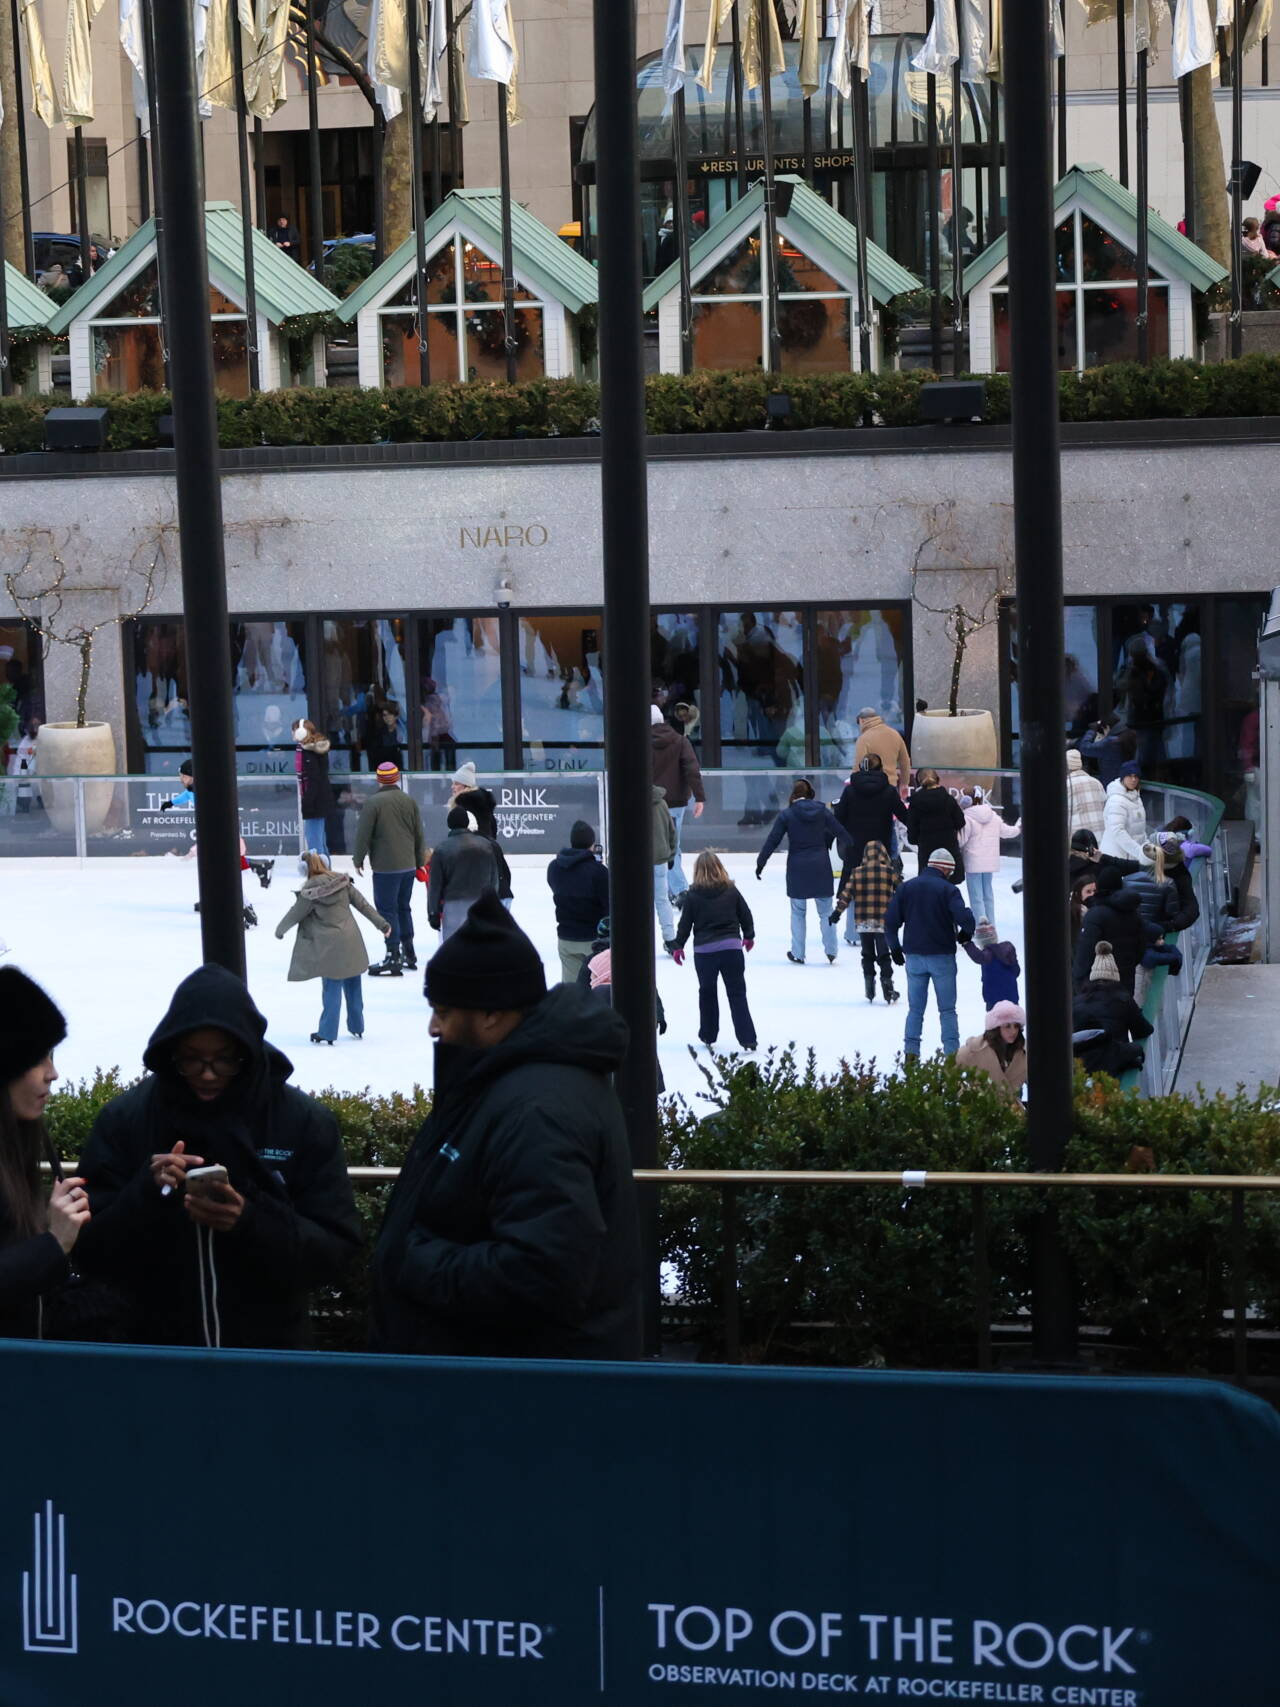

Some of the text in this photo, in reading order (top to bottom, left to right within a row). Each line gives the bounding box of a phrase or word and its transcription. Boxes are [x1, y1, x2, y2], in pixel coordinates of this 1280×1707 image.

[710, 157, 799, 173] RESTURNTS
[460, 524, 548, 548] NARO
[501, 788, 547, 807] RINK
[142, 816, 196, 825] AT ROCKEFELL
[240, 821, 260, 837] HE
[112, 1596, 545, 1659] ROCKEFELLER CENTER
[647, 1603, 1137, 1674] TOP OF THE ROCK
[648, 1663, 1138, 1707] OBSERVATION DECK AT ROCKEFELLER CENTER
